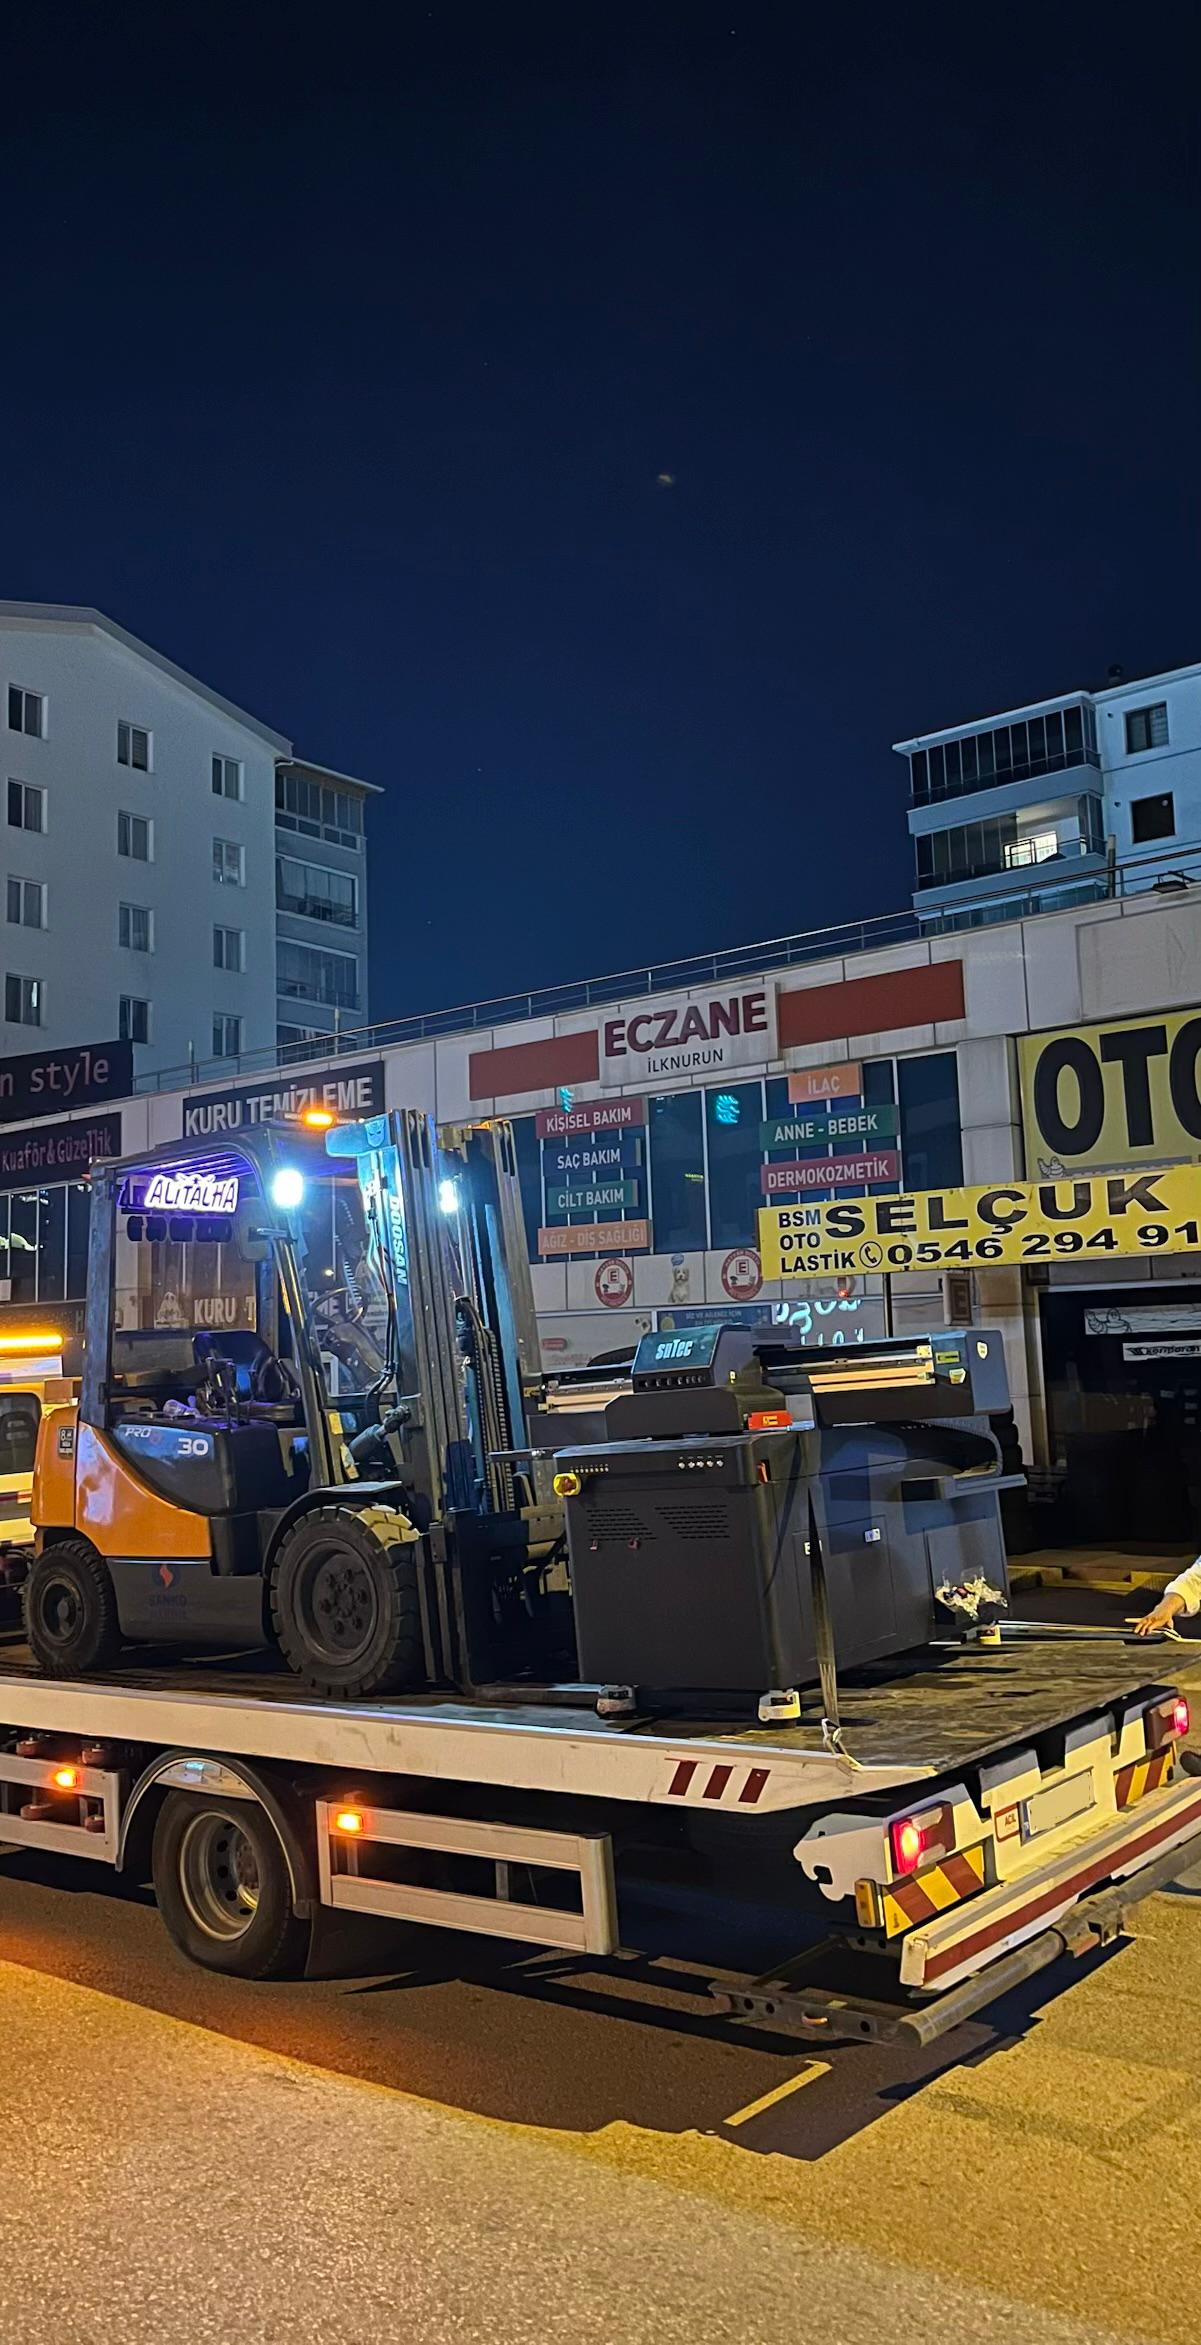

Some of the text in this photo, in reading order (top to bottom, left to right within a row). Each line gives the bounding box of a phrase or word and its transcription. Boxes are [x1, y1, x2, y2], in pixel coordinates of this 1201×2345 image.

[604, 992, 768, 1057] ECZANE
[30, 1051, 109, 1096] style
[647, 1048, 723, 1073] İLKNURUN
[807, 1075, 840, 1095] İLAÇ
[185, 1077, 373, 1137] KURU TEMİZLEME
[593, 1107, 632, 1126] BAKIM
[774, 1122, 814, 1142] ANNE
[828, 1114, 878, 1136] BEBEK
[557, 1148, 621, 1169] SAÇ BAKIM
[767, 1157, 889, 1188] DERMOKOZMETİK
[558, 1188, 625, 1208] CİLT BAKIM
[779, 1174, 1170, 1237] BSM SELÇUK
[389, 1194, 408, 1286] DOOSAN
[543, 1231, 567, 1249] AĞIZ
[577, 1230, 596, 1248] DİŞ
[599, 1225, 644, 1243] SAĞLIĞI
[779, 1232, 821, 1250] OTO
[781, 1249, 857, 1273] LASTİK
[887, 1238, 1004, 1265] 0546
[1021, 1228, 1119, 1256] 294
[1137, 1221, 1199, 1248] 91
[194, 1298, 236, 1325] KURU
[124, 1427, 151, 1438] PRO
[178, 1438, 209, 1456] 30
